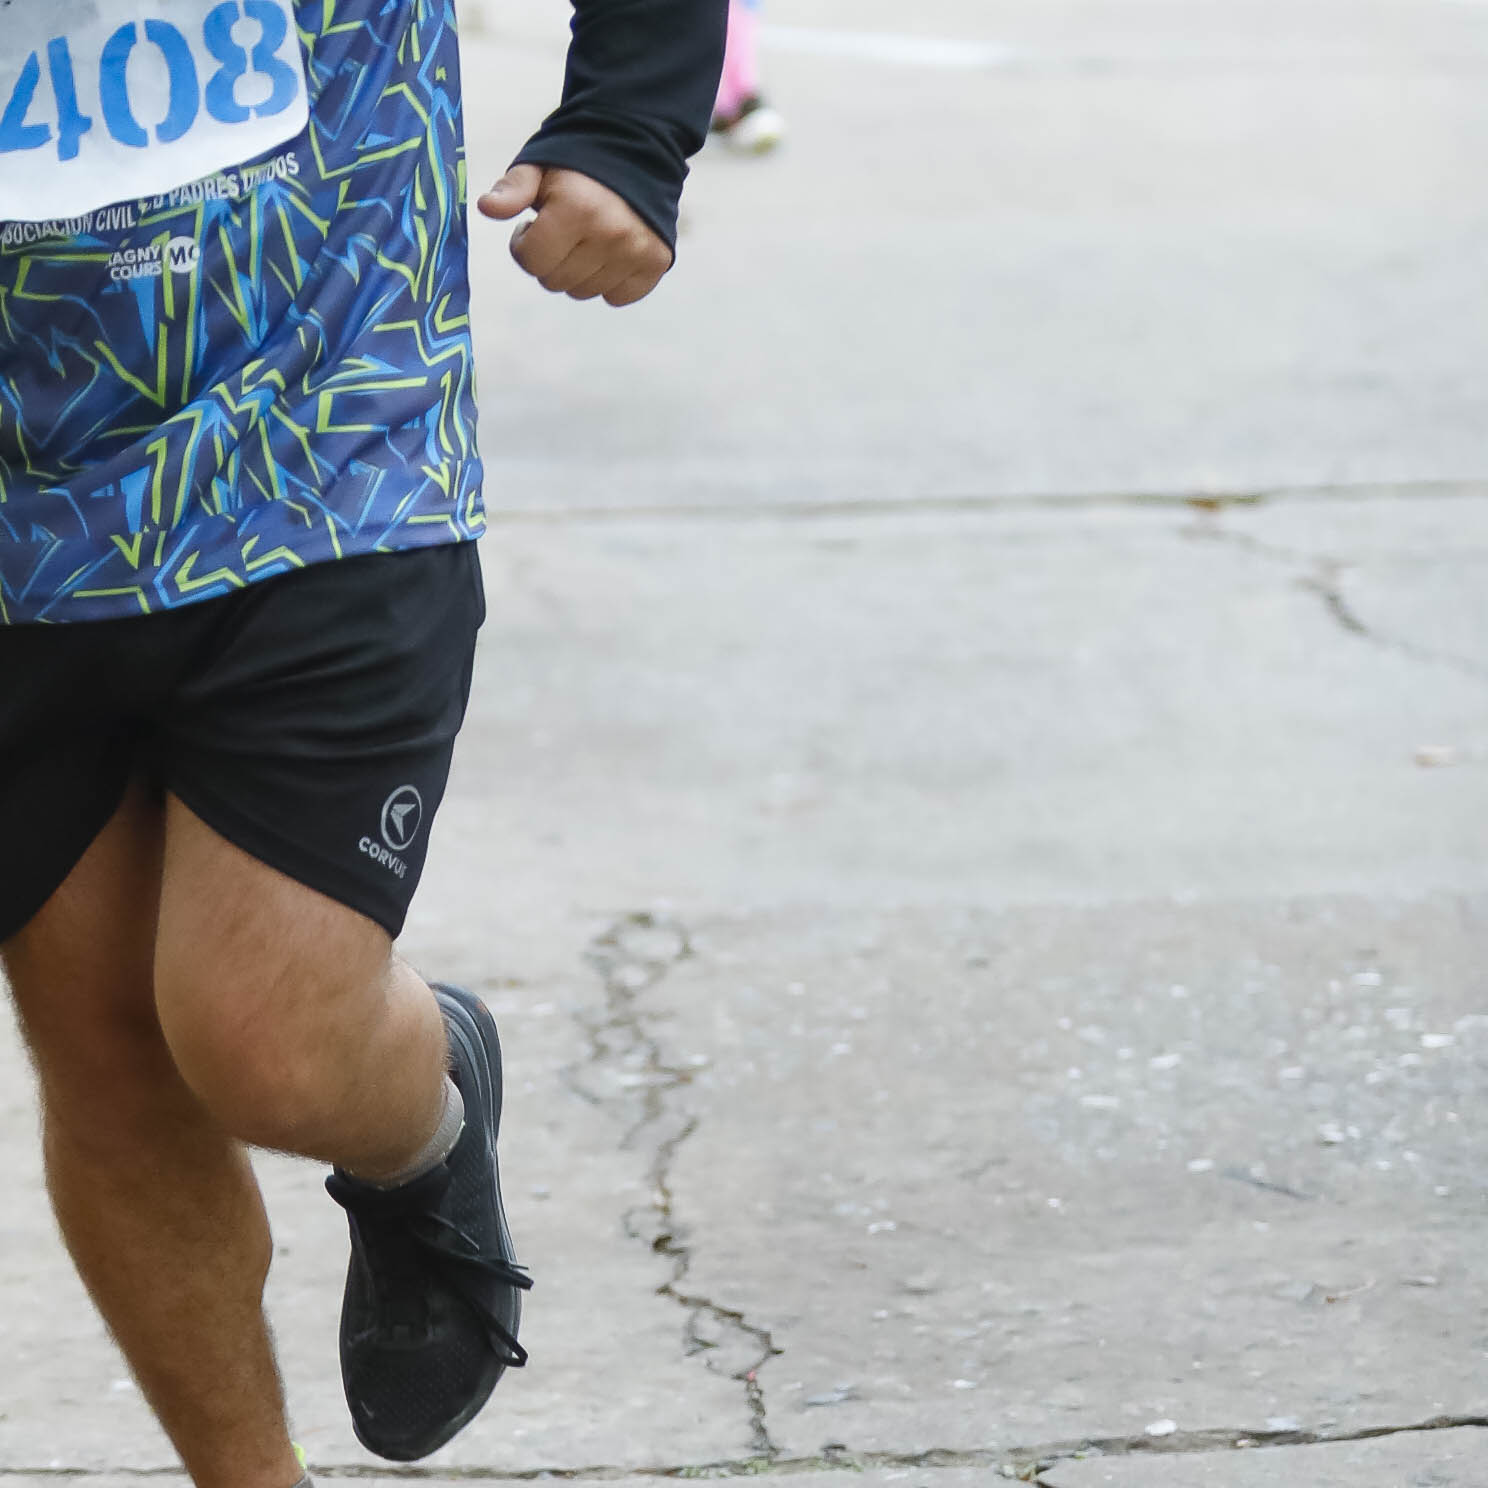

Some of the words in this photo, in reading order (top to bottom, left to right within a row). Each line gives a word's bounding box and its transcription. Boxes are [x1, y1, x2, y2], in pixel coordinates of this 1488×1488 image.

[96, 204, 137, 232] CIVIL
[169, 173, 240, 207] PADRES
[106, 244, 161, 268] AGNY
